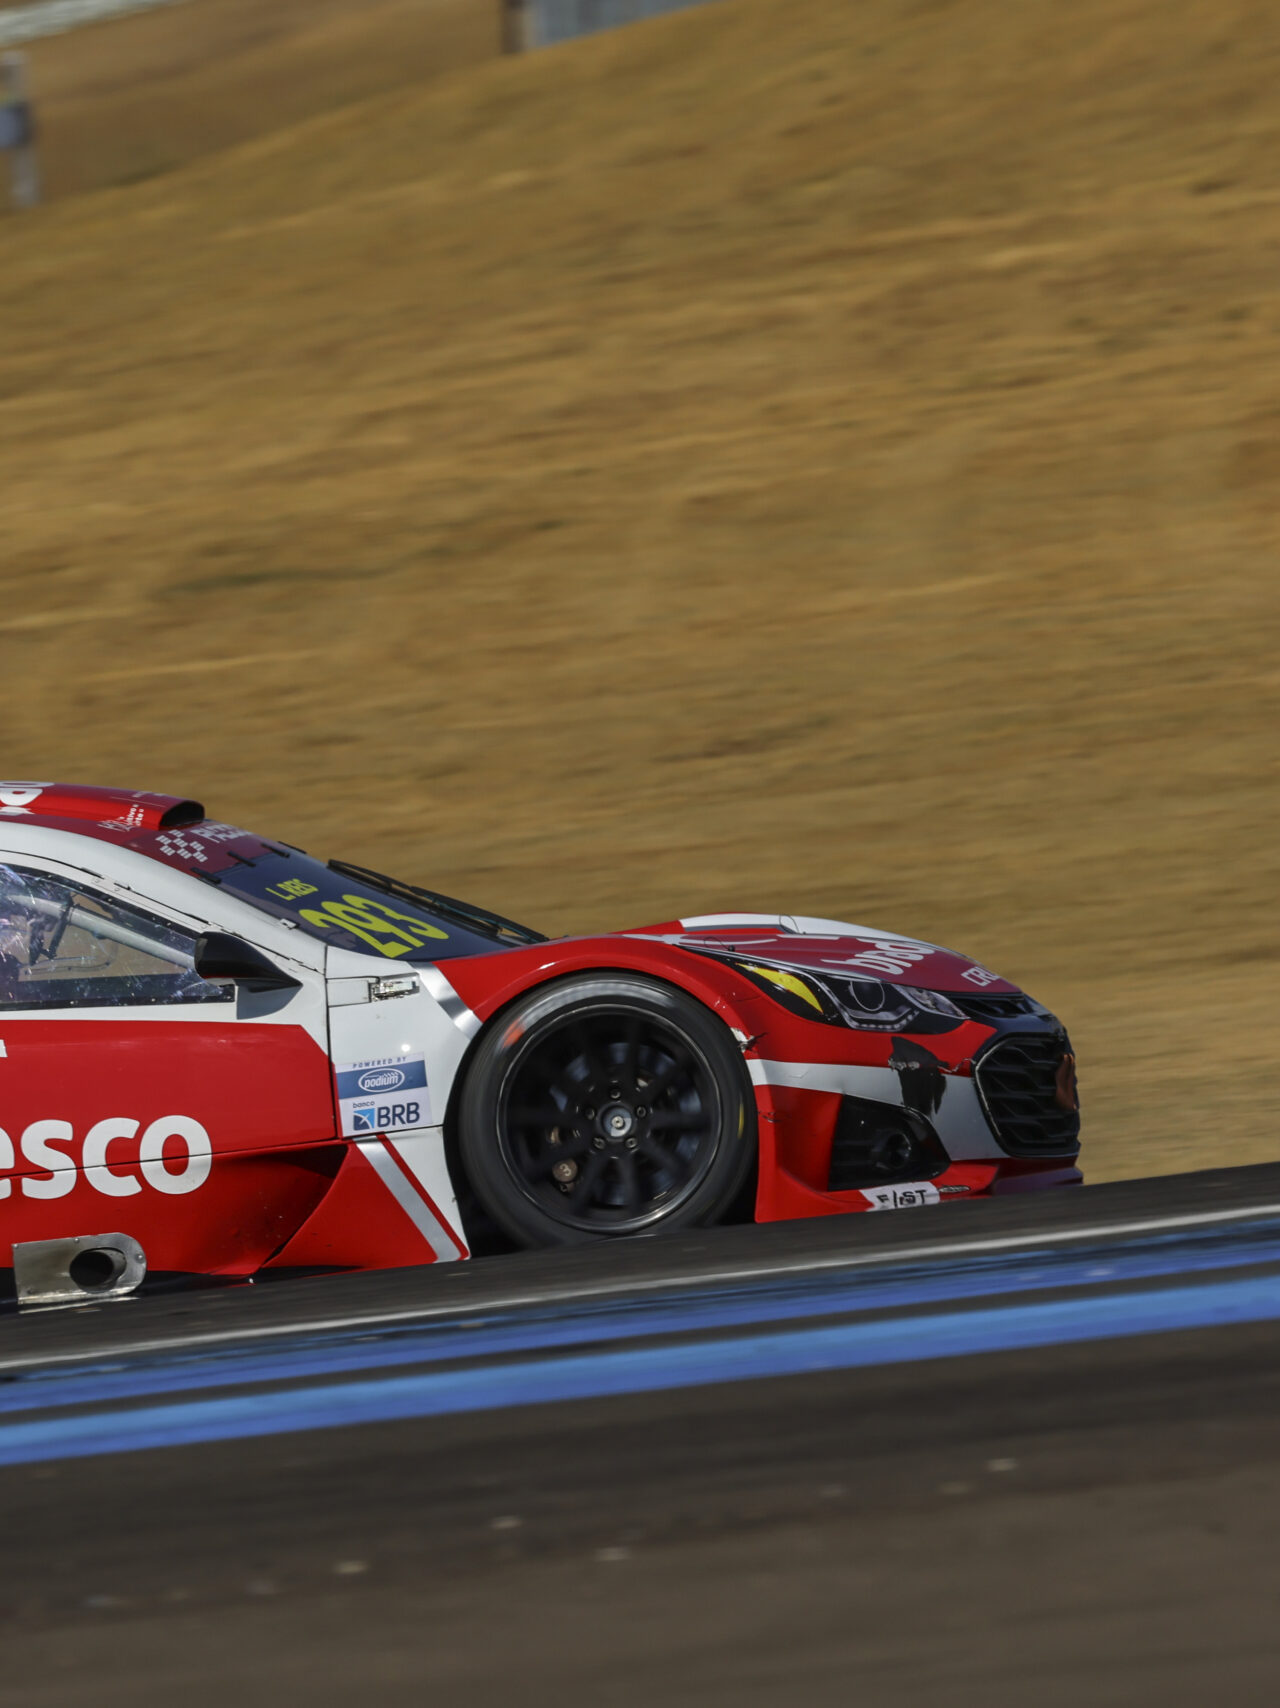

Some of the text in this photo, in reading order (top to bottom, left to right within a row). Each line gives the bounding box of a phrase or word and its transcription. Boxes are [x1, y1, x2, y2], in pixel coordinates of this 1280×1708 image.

[299, 894, 450, 958] 293
[352, 1056, 407, 1069] POWERED BY
[364, 1072, 399, 1088] podium
[352, 1100, 376, 1109] banco
[376, 1102, 421, 1128] BRB
